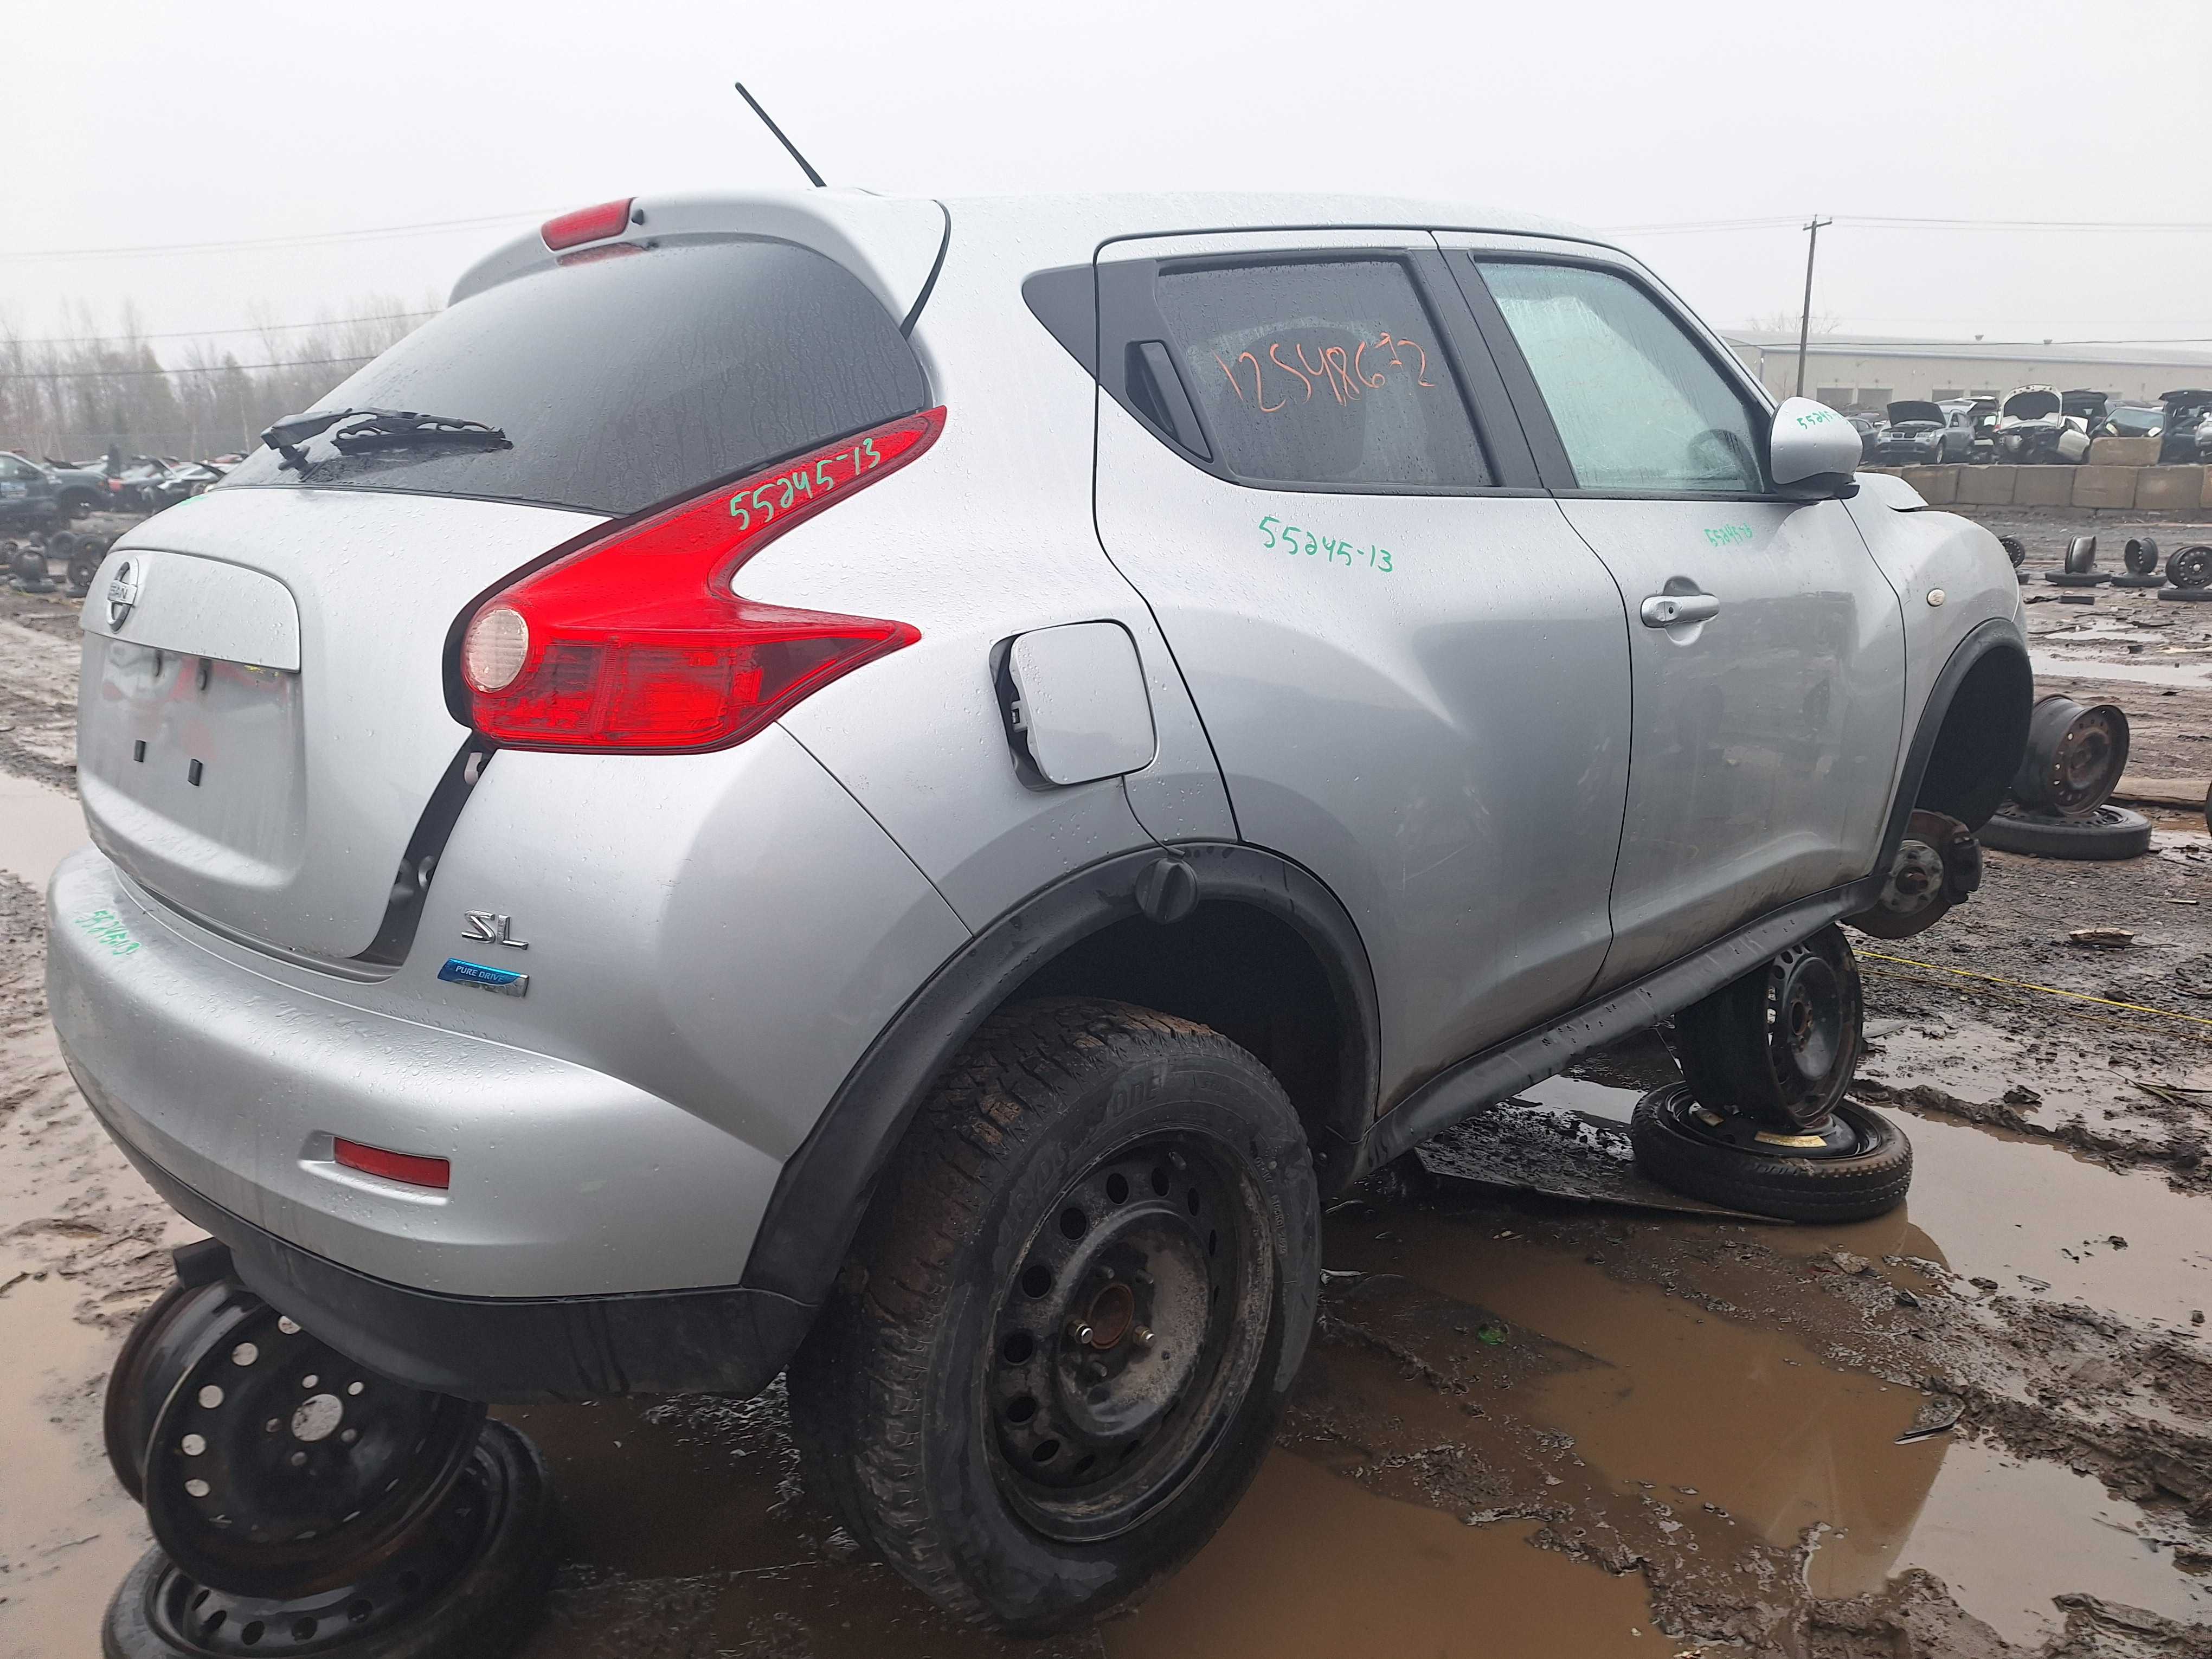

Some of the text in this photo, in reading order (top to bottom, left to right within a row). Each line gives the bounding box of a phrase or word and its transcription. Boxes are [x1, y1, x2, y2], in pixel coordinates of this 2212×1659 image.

[730, 438, 880, 530] 55245-13
[1259, 516, 1392, 572] 55245-13
[461, 910, 529, 950] SL
[455, 966, 504, 982] PURE DRIVE
